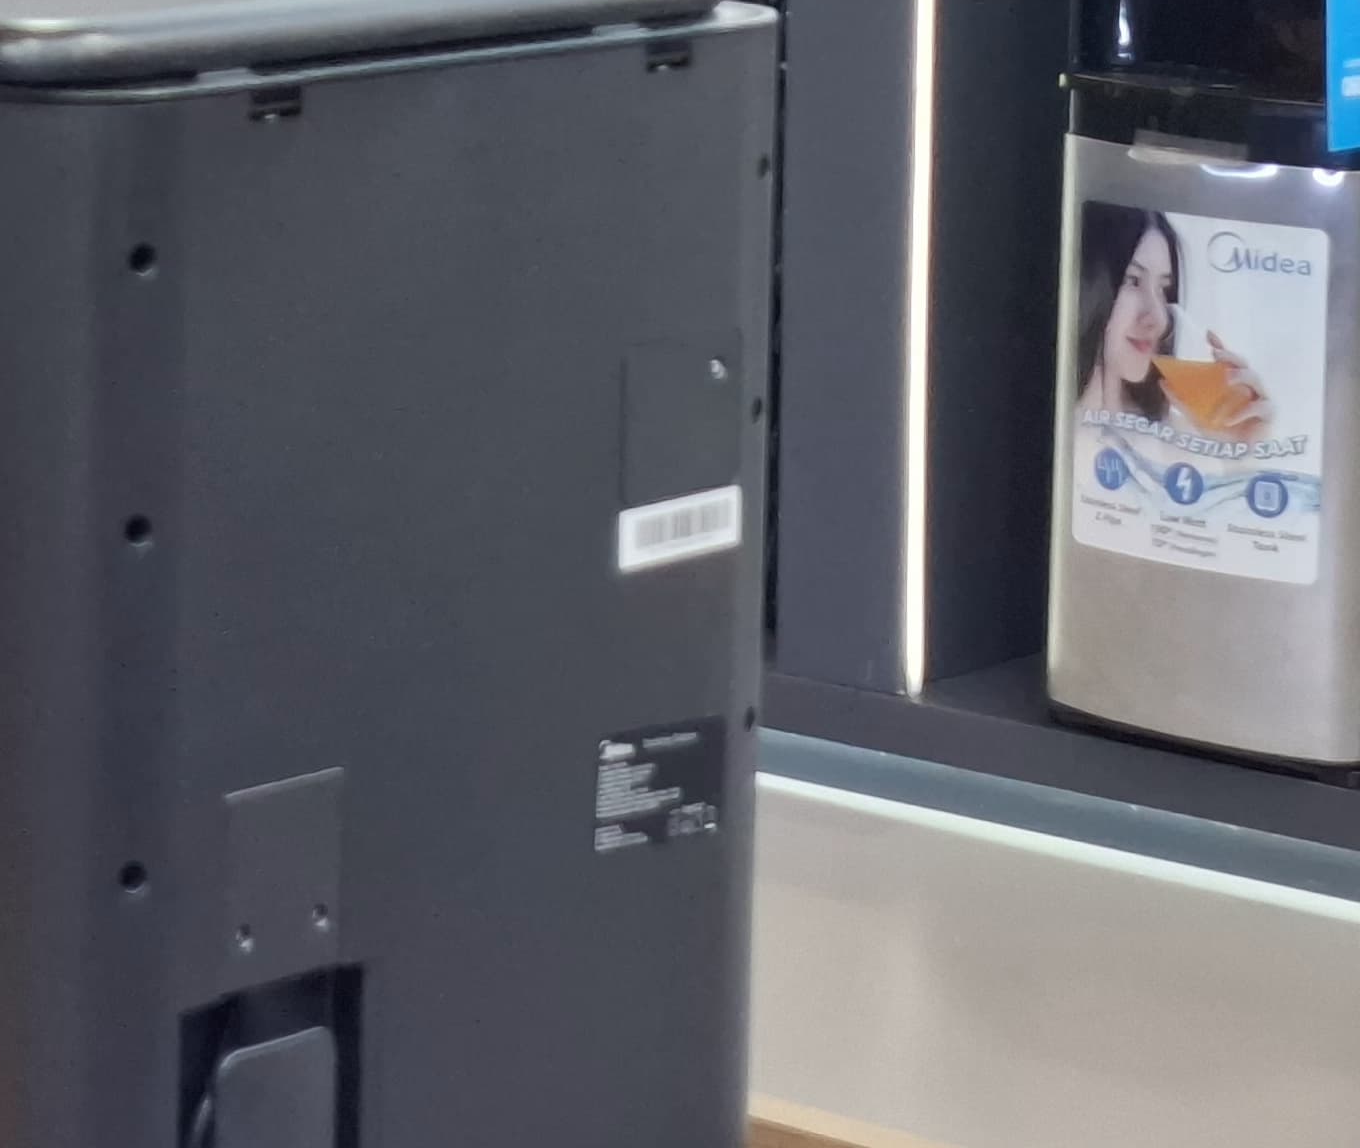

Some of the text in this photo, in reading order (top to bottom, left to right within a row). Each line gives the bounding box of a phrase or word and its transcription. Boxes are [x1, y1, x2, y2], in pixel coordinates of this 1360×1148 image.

[1207, 231, 1312, 276] Midea
[1114, 411, 1174, 442] SEGAR
[1177, 431, 1249, 460] SETIAP
